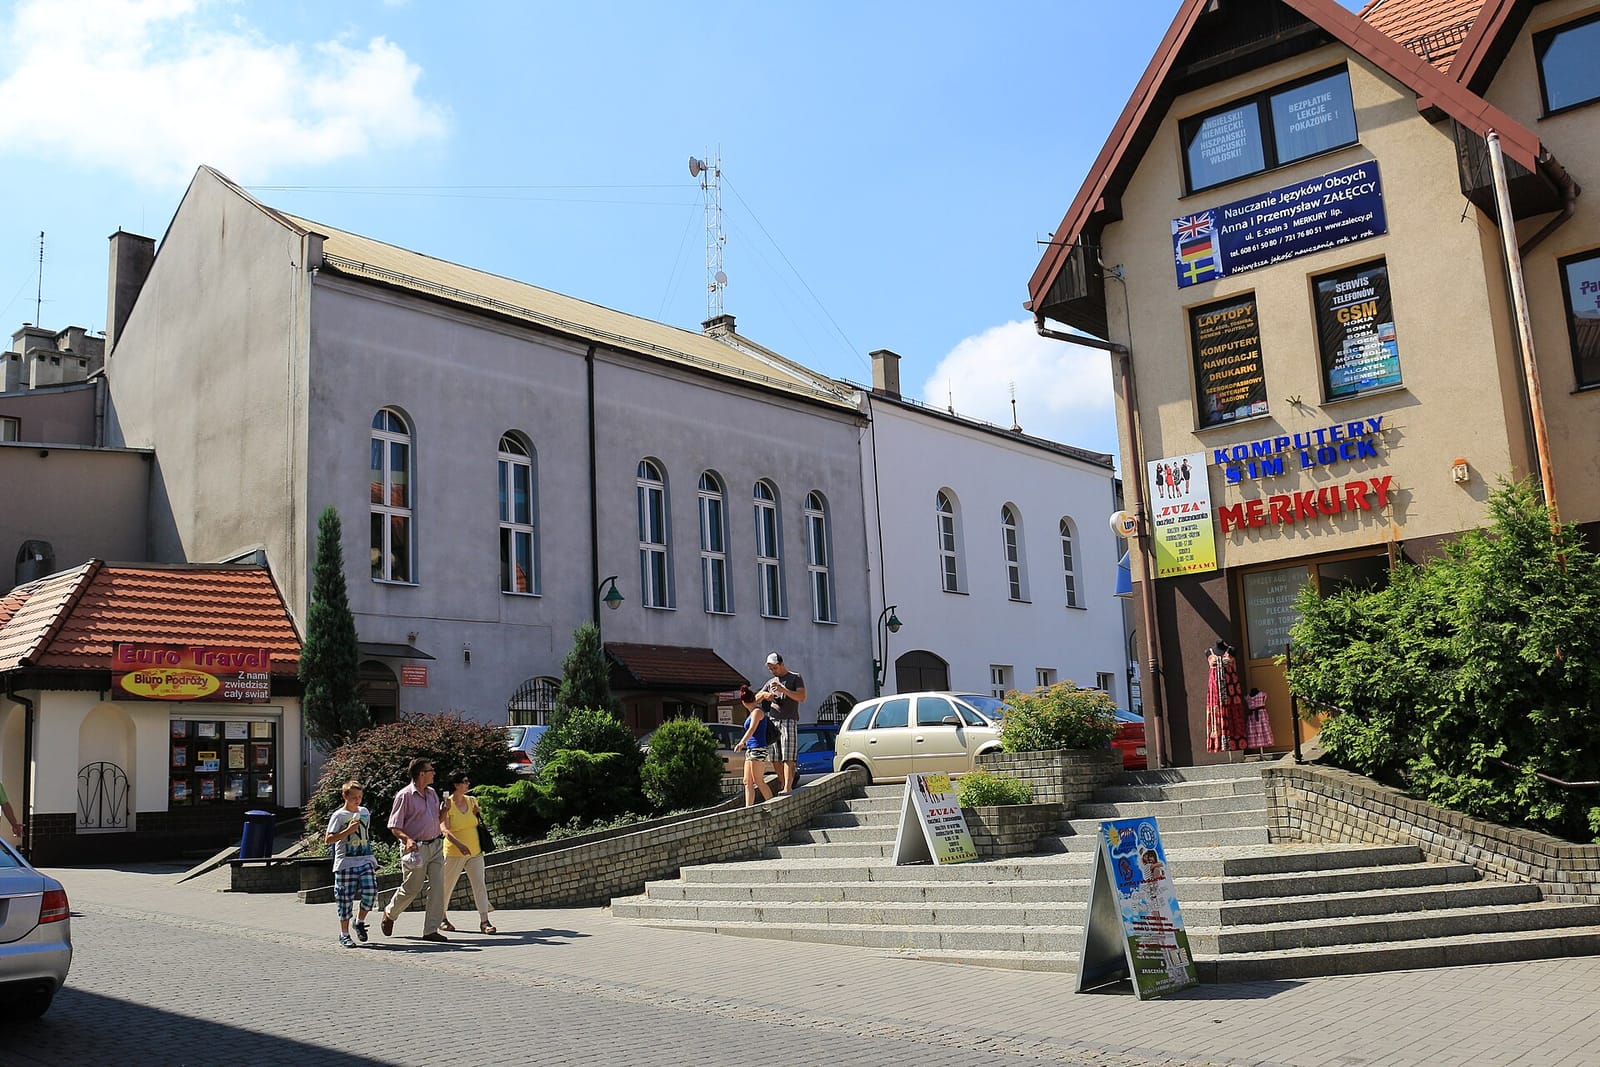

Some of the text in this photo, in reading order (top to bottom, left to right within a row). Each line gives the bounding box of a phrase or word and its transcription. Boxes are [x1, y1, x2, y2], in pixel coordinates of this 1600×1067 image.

[1289, 92, 1332, 113] BEZPŁATNE
[1297, 104, 1326, 120] LEKCJE
[1290, 112, 1332, 133] POKAZOWE
[1224, 169, 1366, 219] Nauczanie Języków Obcych
[1221, 220, 1248, 235] Anna
[1256, 199, 1320, 225] Przemysław
[1323, 181, 1376, 205] ZAŁĘCCY
[1264, 225, 1282, 236] Stein
[1283, 222, 1288, 230] 3
[1293, 211, 1327, 227] MERKURY
[1240, 246, 1251, 255] 608
[1252, 243, 1260, 251] 61
[1260, 241, 1269, 249] 50
[1269, 238, 1277, 246] 80
[1285, 233, 1296, 242] 721
[1297, 230, 1305, 238] 76
[1305, 228, 1314, 236] 80
[1314, 226, 1322, 234] 51
[1325, 211, 1373, 231] www.zaleccy.pl
[1231, 259, 1269, 274] Najwyższa
[1335, 276, 1369, 293] SERWIS
[1333, 287, 1374, 304] TELEFONÓW
[1198, 305, 1252, 328] LAPTOPY
[1337, 300, 1377, 323] GSM
[1343, 316, 1374, 327] NOKIA
[1346, 322, 1372, 333] SONY
[1347, 329, 1373, 340] BOSH
[1200, 336, 1258, 356] KOMPUTERY
[1203, 350, 1259, 370] NAWIGACJE
[1343, 362, 1385, 375] ALCATEL
[1209, 363, 1257, 381] DRUKARKI
[1344, 369, 1386, 382] SIEMENS
[1213, 415, 1383, 465] KOMPUTERY
[1225, 438, 1377, 484] SIM LOCK
[1218, 475, 1393, 534] MERKURY
[1160, 561, 1216, 575] ZAPRASZAMY
[1267, 585, 1287, 594] LAMPY
[1266, 606, 1293, 615] PLECAK
[119, 643, 267, 668] Euro Travel
[134, 674, 208, 688] Biuro Podróży
[238, 671, 268, 680] Z nami
[224, 680, 269, 689] zwiedzisz
[224, 690, 243, 700] cały
